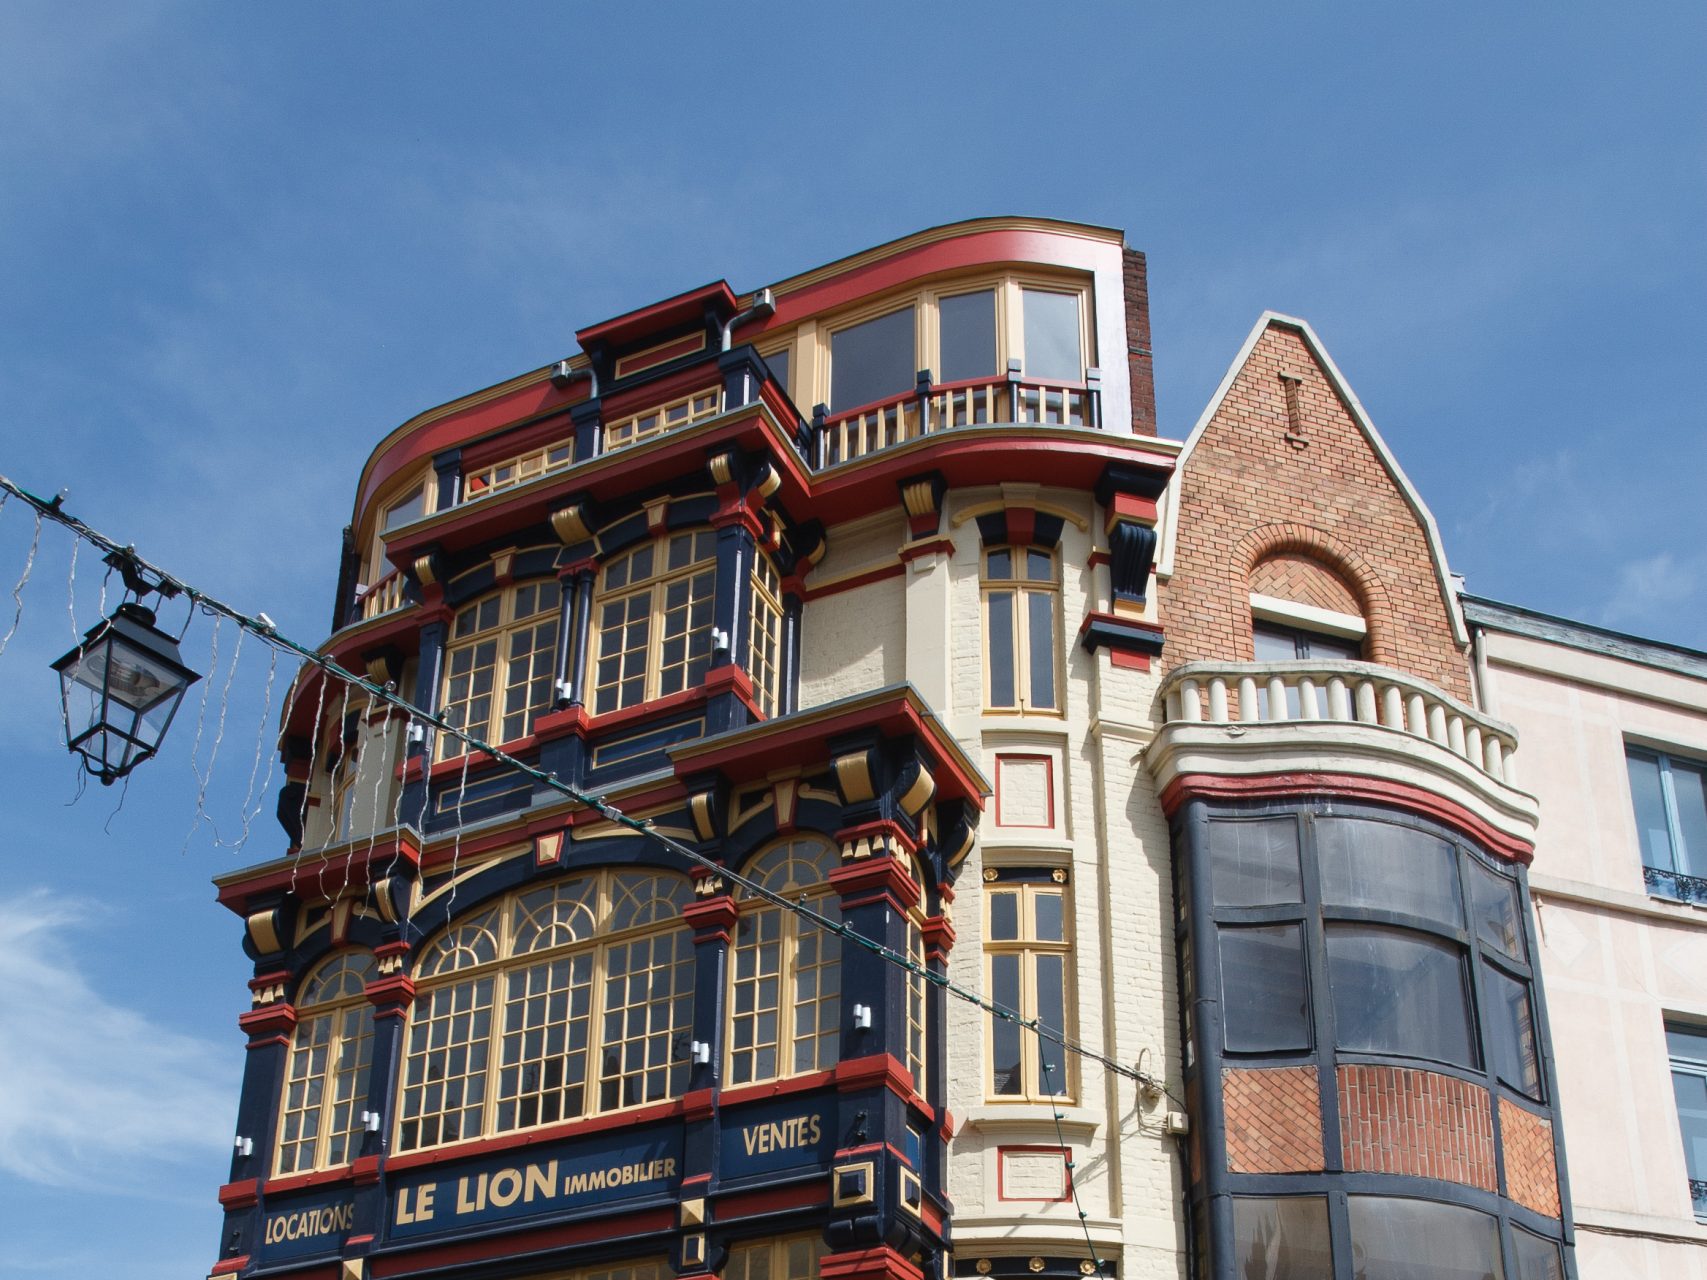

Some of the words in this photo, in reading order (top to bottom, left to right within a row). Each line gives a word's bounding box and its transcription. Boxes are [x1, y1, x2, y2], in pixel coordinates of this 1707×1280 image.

[742, 1113, 821, 1156] VENTES
[395, 1183, 437, 1226] LE
[456, 1160, 559, 1215] LION
[564, 1158, 676, 1196] IMMOBILIER
[265, 1202, 354, 1245] LOCATIONS
